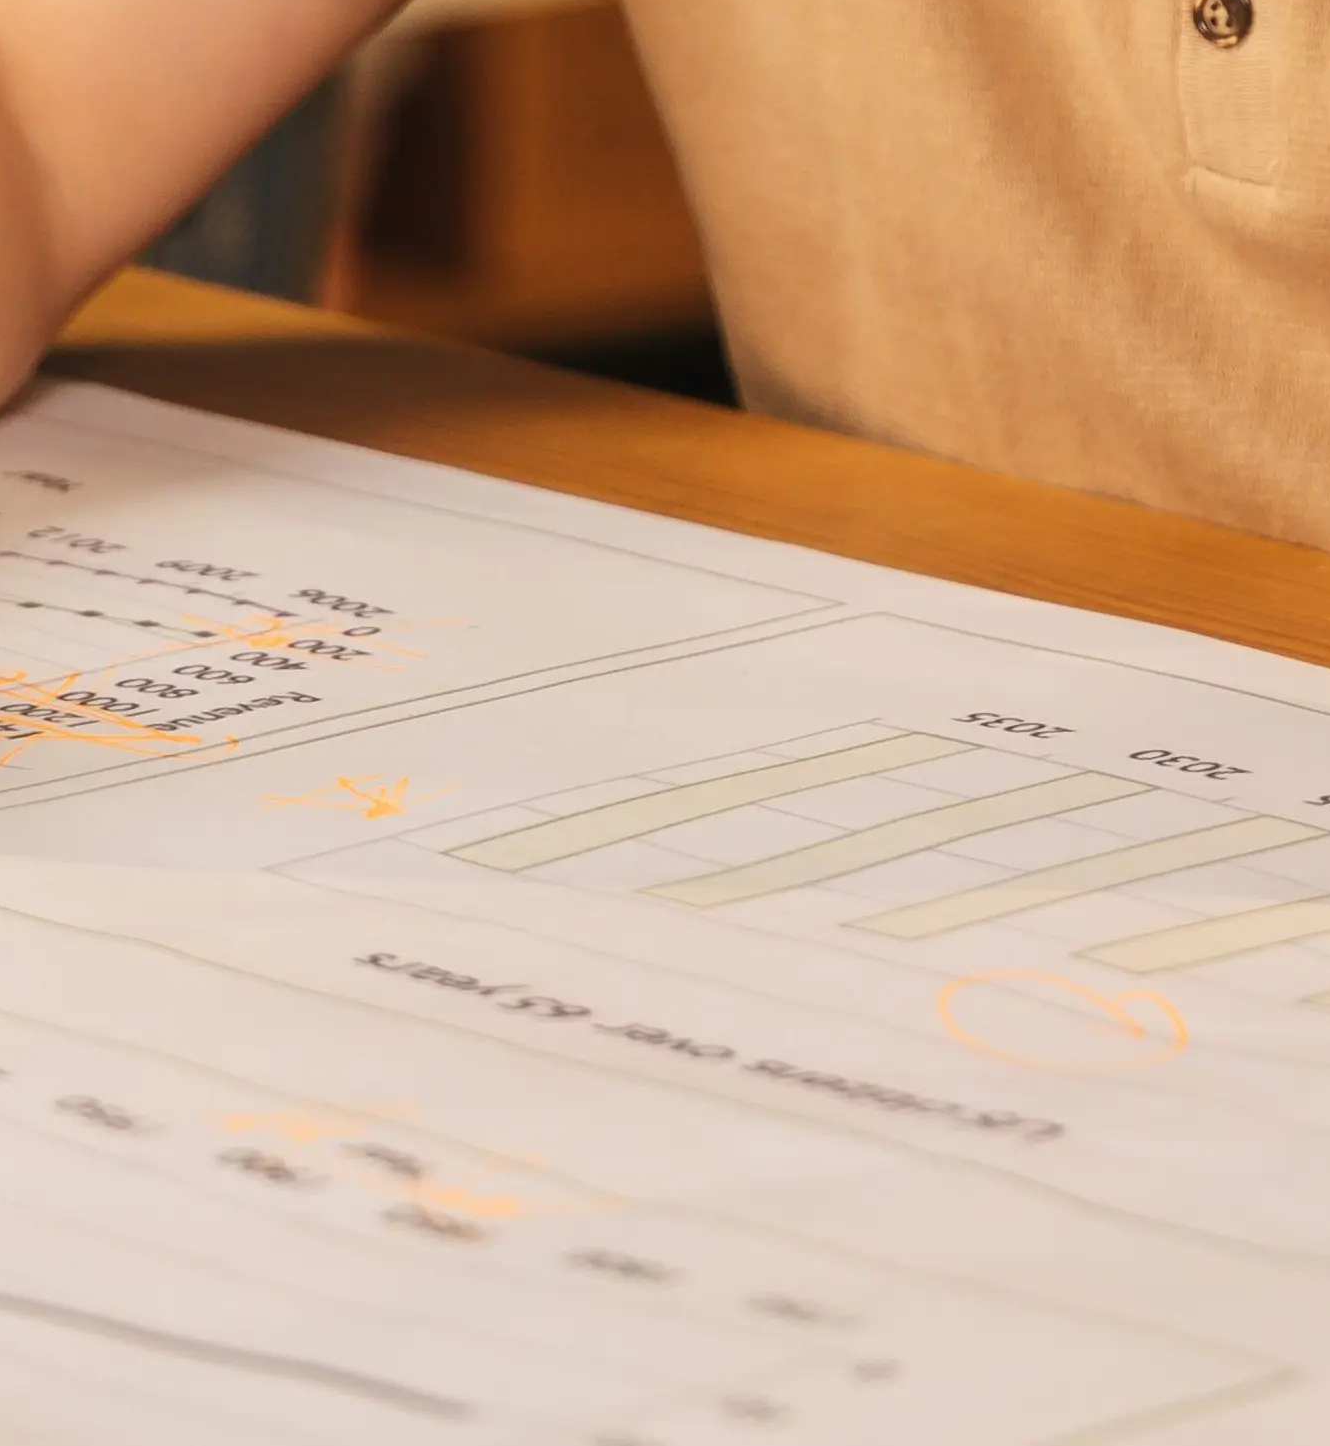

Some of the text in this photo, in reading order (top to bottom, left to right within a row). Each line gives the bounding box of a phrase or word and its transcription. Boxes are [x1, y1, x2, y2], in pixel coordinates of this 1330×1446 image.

[28, 524, 129, 554] 2012
[155, 559, 262, 583] 2009
[295, 587, 396, 618] 2006
[342, 624, 381, 638] 0
[230, 651, 310, 672] 400
[287, 639, 373, 662] 200
[173, 663, 256, 685] 600
[116, 677, 200, 699] 800
[0, 703, 101, 729] 1200
[56, 690, 159, 718] 1000
[158, 691, 322, 732] Revenue
[950, 708, 1077, 742] 2035
[1128, 746, 1253, 782] 2030
[352, 951, 529, 997] years
[496, 996, 592, 1022] 65
[592, 1023, 734, 1061] over
